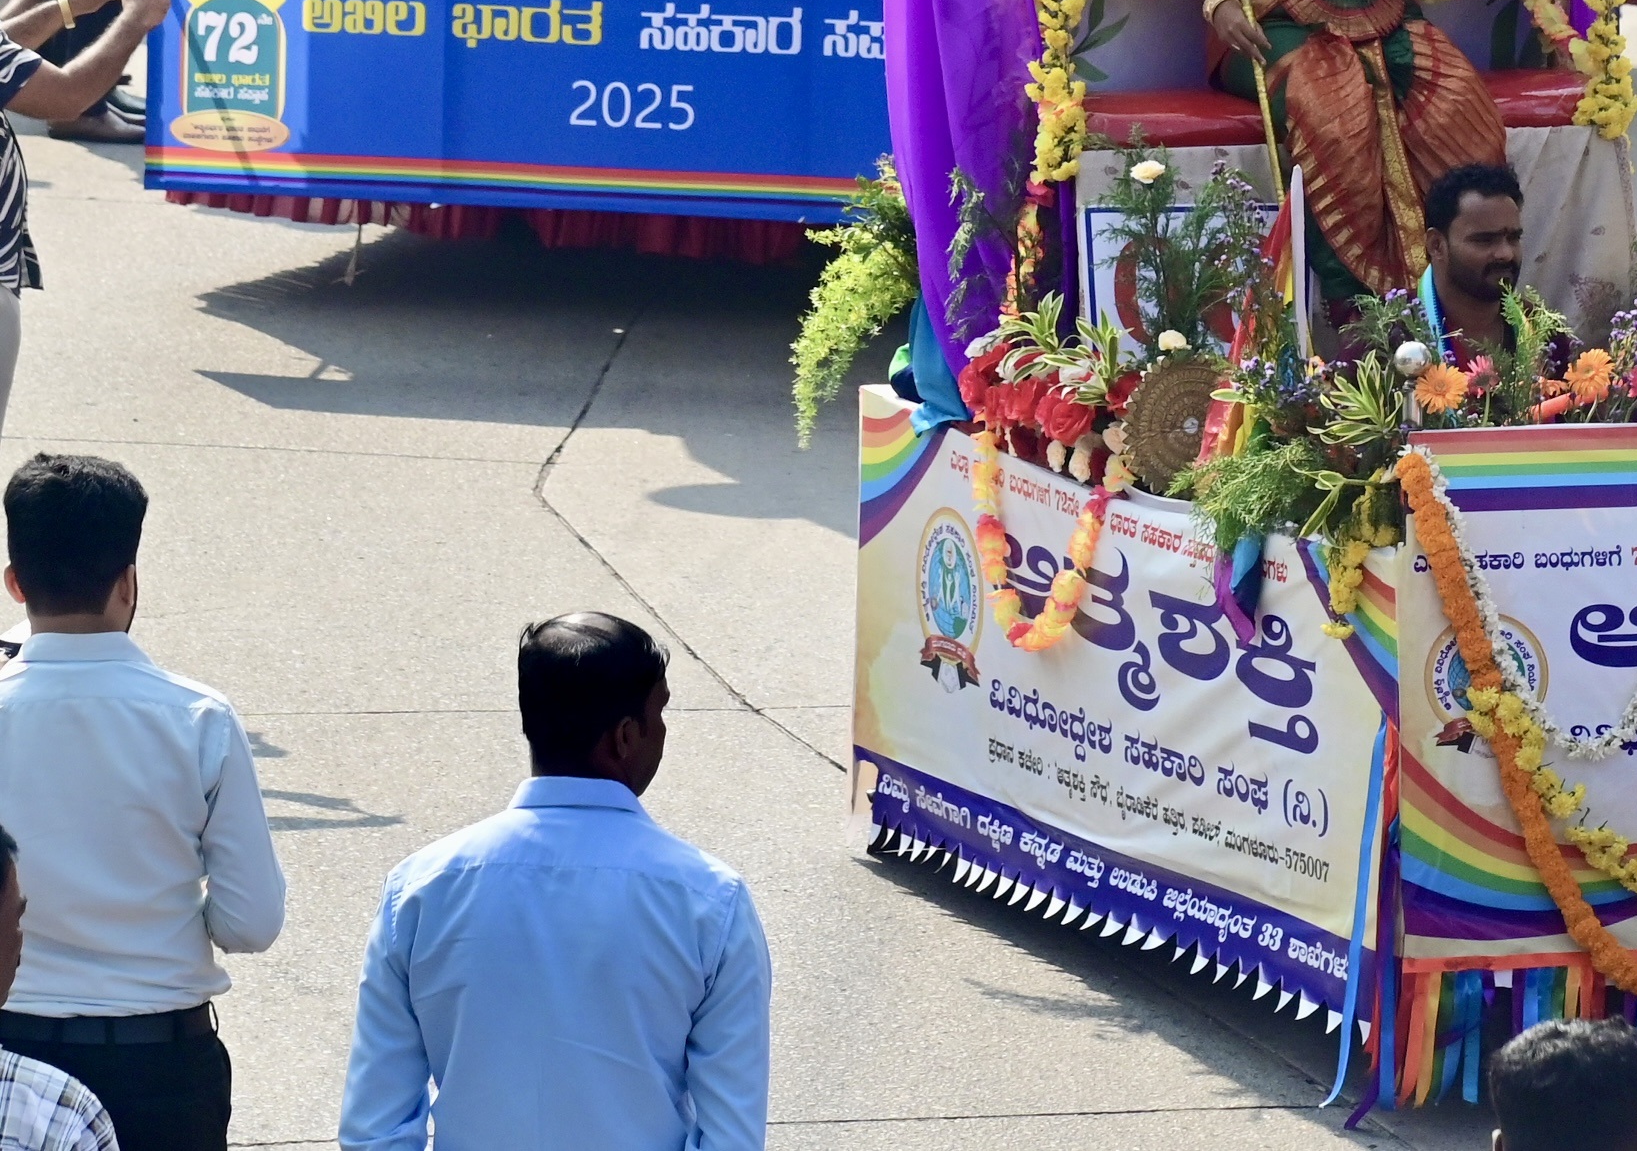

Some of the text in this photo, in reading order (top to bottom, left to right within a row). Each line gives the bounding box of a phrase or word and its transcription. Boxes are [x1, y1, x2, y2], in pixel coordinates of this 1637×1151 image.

[197, 11, 259, 65] 72
[640, 2, 803, 55] ಸಹಕಾರ
[570, 80, 696, 131] 2025
[1110, 511, 1140, 538] ಭಾರತ
[1141, 517, 1184, 553] ಸಹಕಾರ
[1534, 546, 1623, 572] ಬಂಧುಗಳಿಗೆ
[989, 679, 1329, 838] ವಿವಿಧೋದ್ದೇಶ ಸಹಕಾರಿ ಸಂಘ (ನಿ.)
[878, 773, 910, 814] ನಿಮ್ಮ
[915, 785, 972, 829] ಸೇವೆಗಾಗಿ
[977, 812, 1014, 853] ದಕ್ಷಿಣ
[1019, 830, 1064, 872] ಕನ್ನಡ
[1066, 848, 1105, 888] ಮತ್ತು
[1109, 866, 1158, 901] ಉಡುಪಿ
